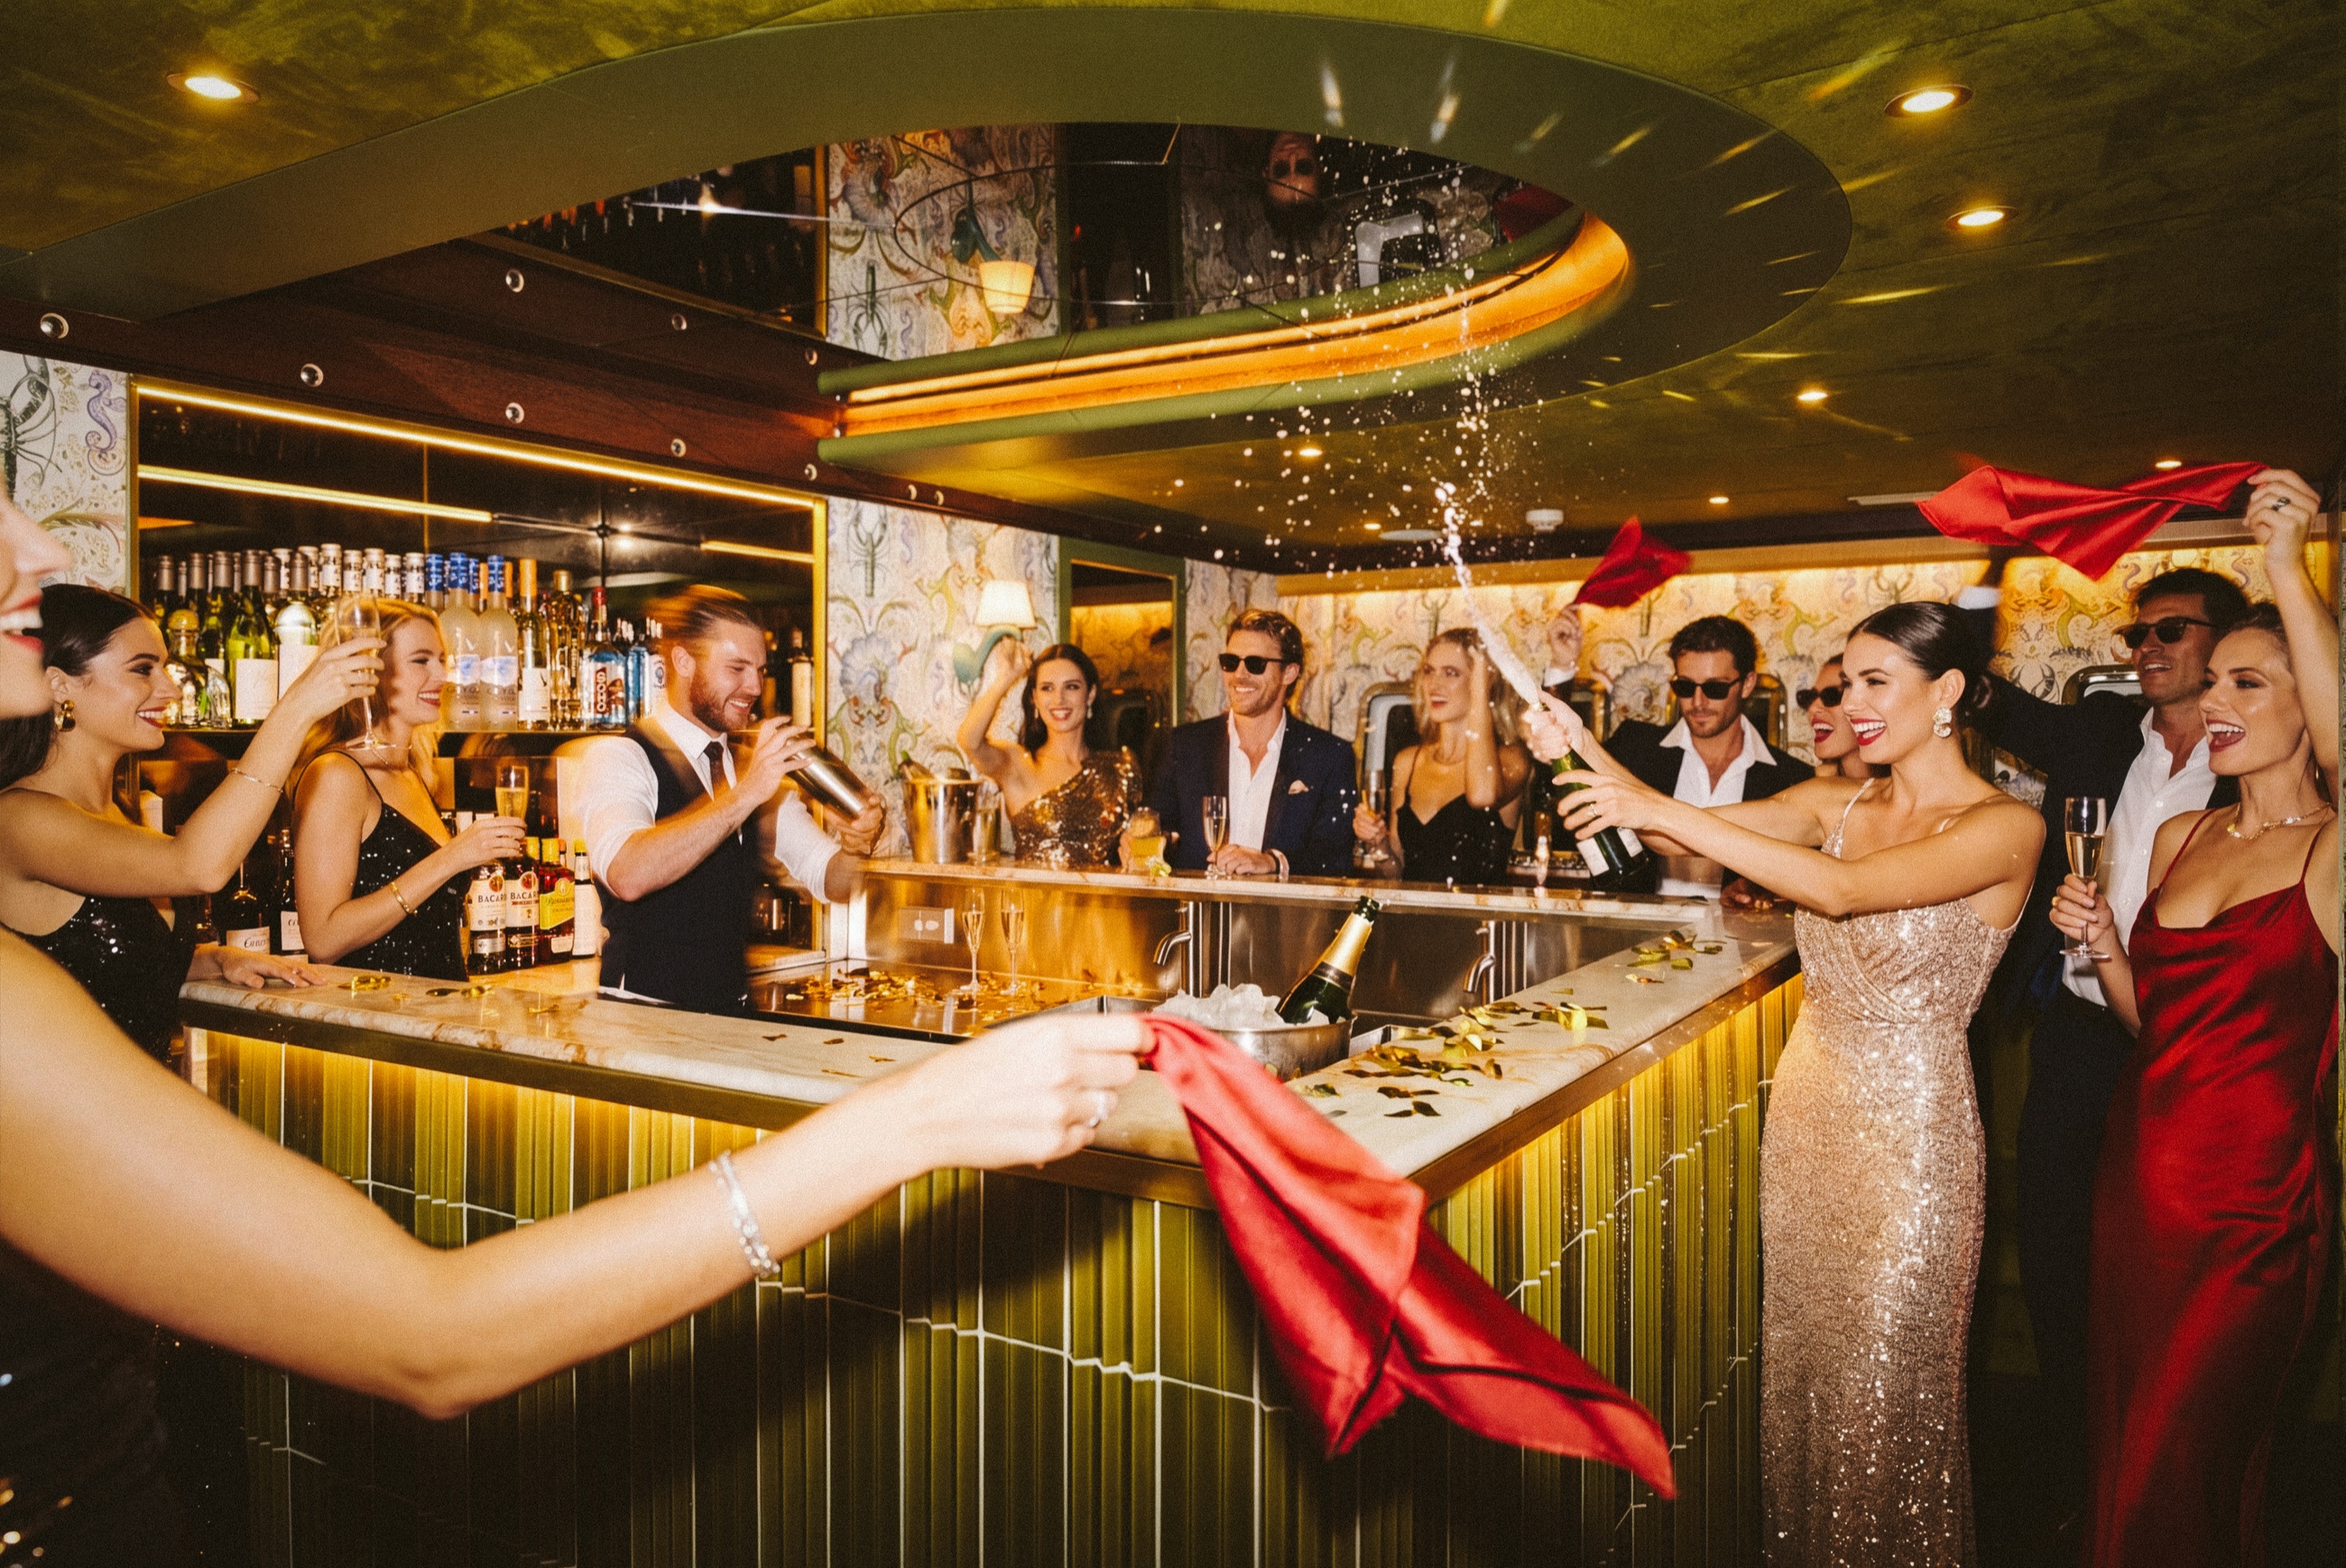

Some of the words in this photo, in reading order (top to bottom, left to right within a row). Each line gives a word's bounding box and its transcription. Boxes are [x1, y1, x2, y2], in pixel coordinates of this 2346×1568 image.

[596, 670, 606, 712] SOHO
[478, 893, 505, 902] BACAR
[511, 891, 539, 899] BACAR
